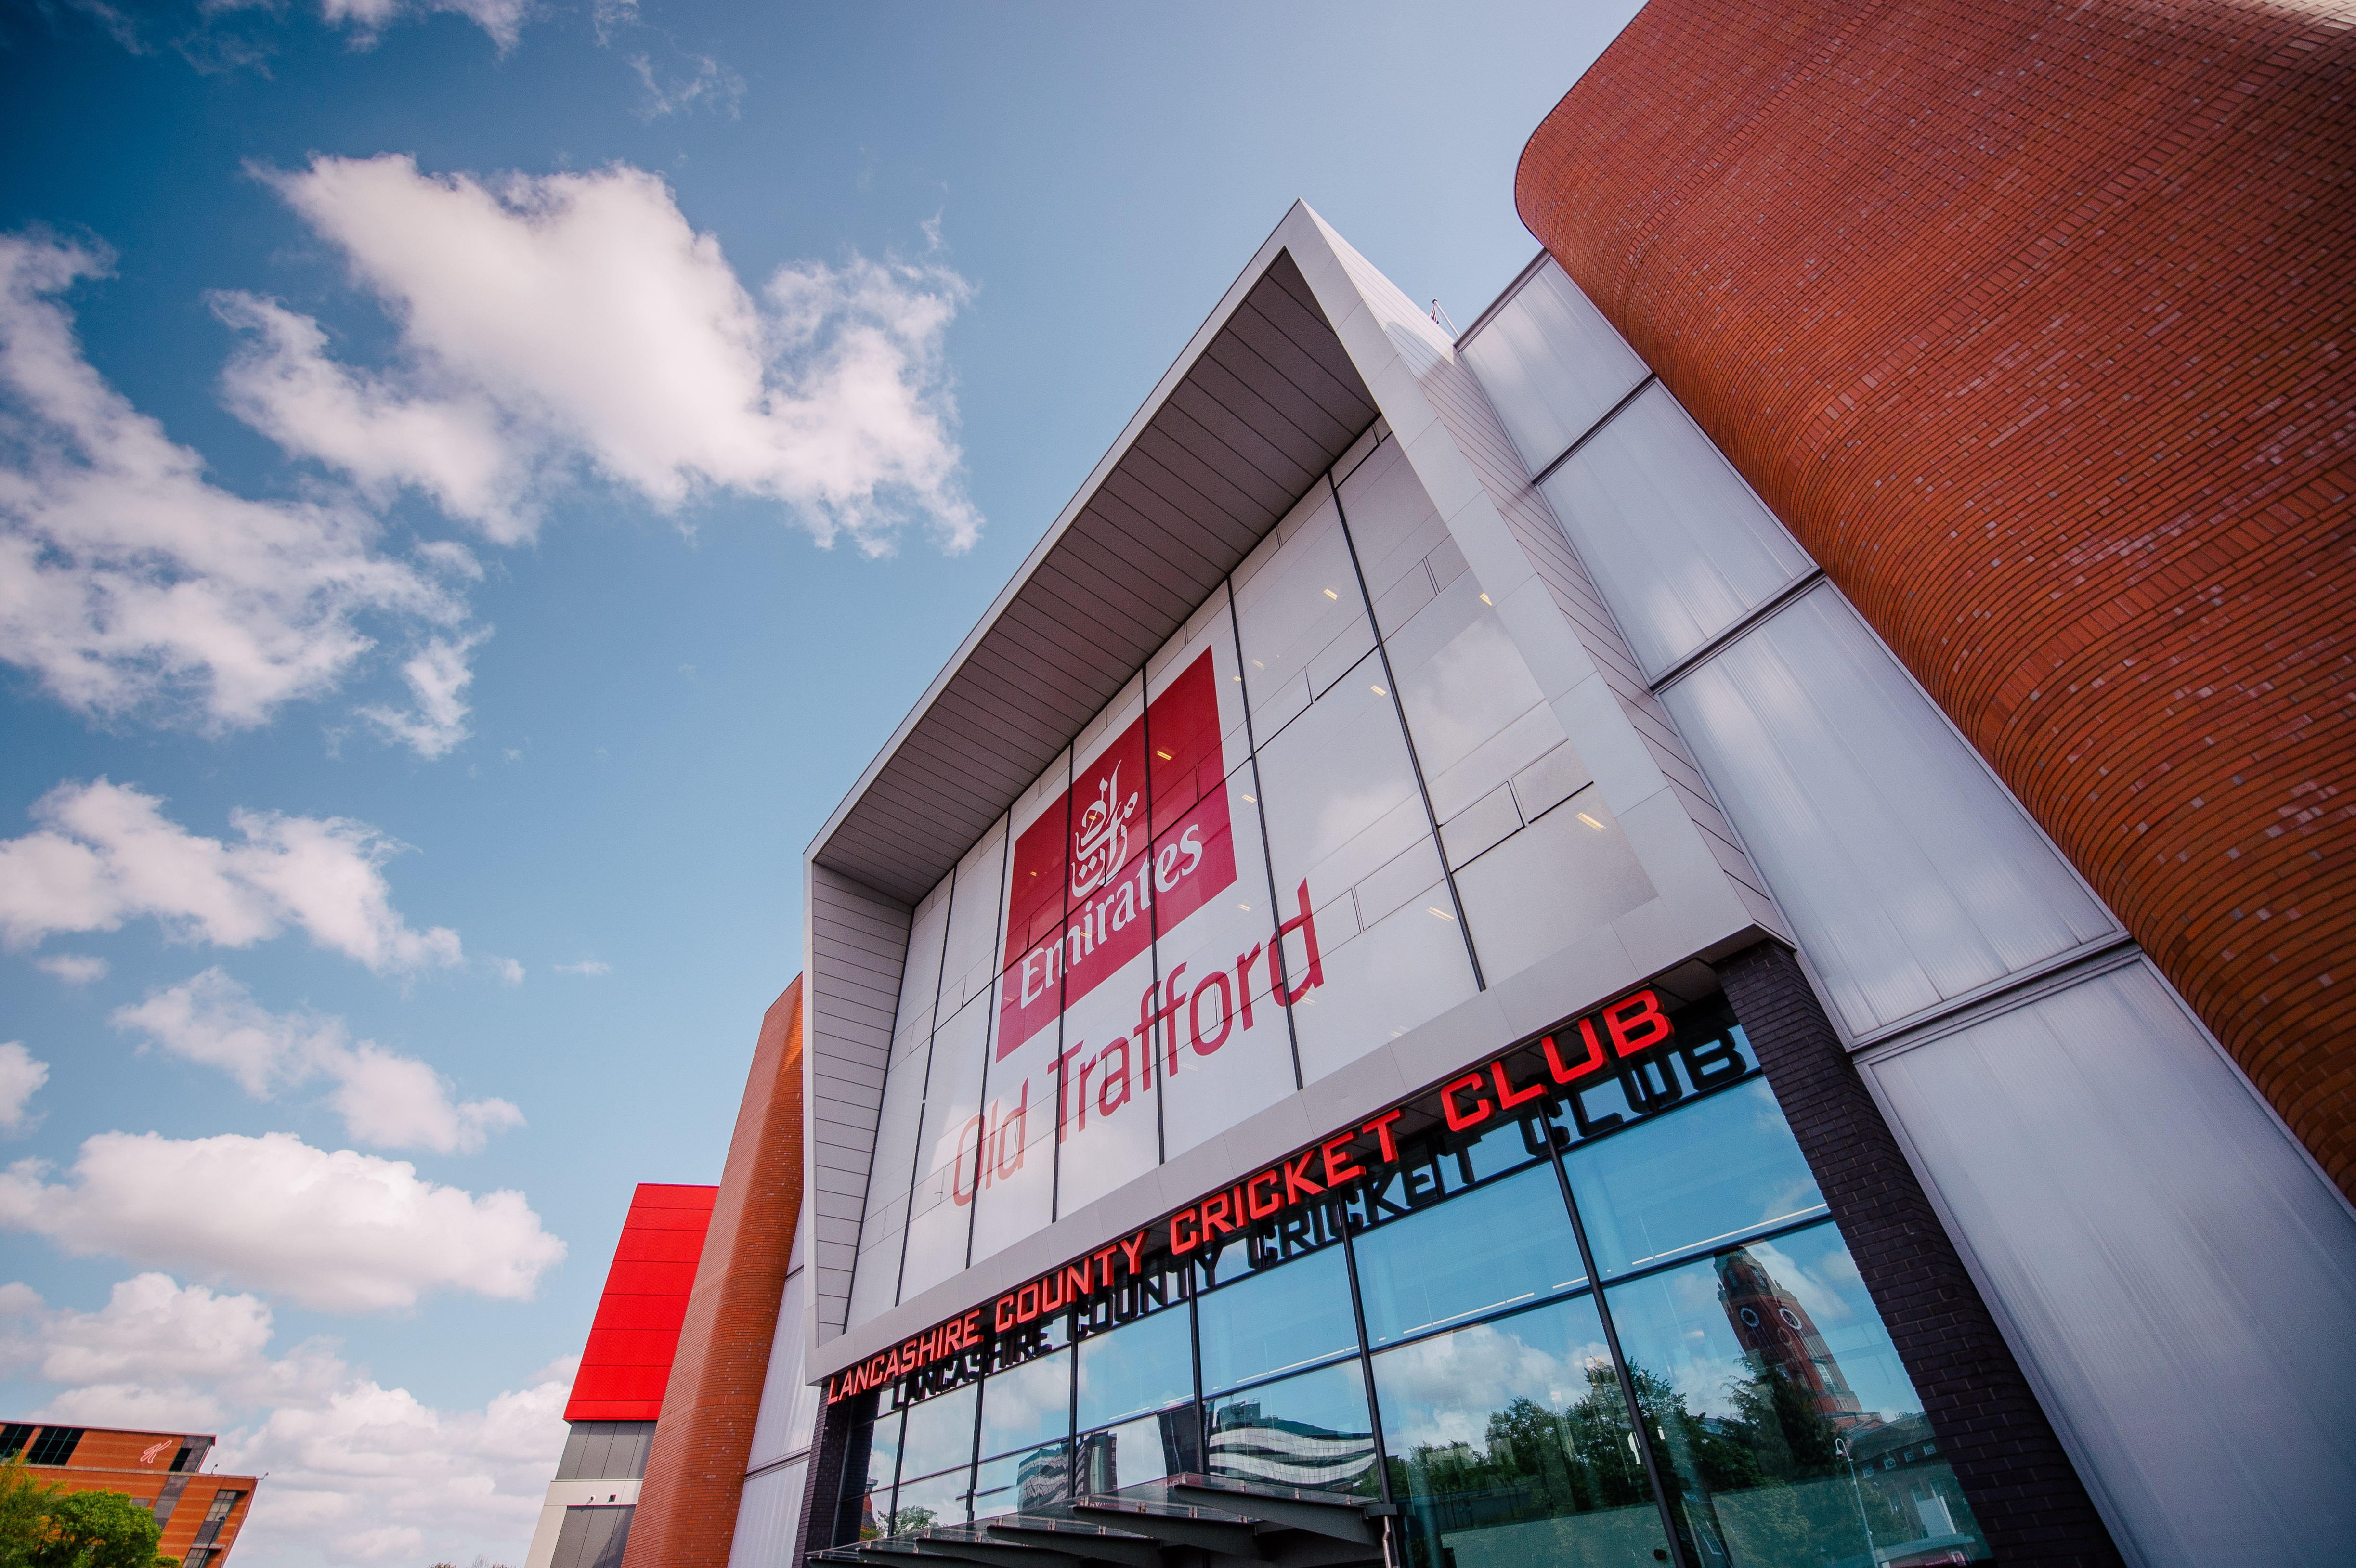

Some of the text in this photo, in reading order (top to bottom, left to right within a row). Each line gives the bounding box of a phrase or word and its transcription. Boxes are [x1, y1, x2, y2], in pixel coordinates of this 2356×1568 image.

[952, 878, 1324, 1207] Old Trafford
[1020, 823, 1203, 1009] Emirates
[827, 990, 1674, 1405] LANCASHIRE COUNTY CRICKET CLUB
